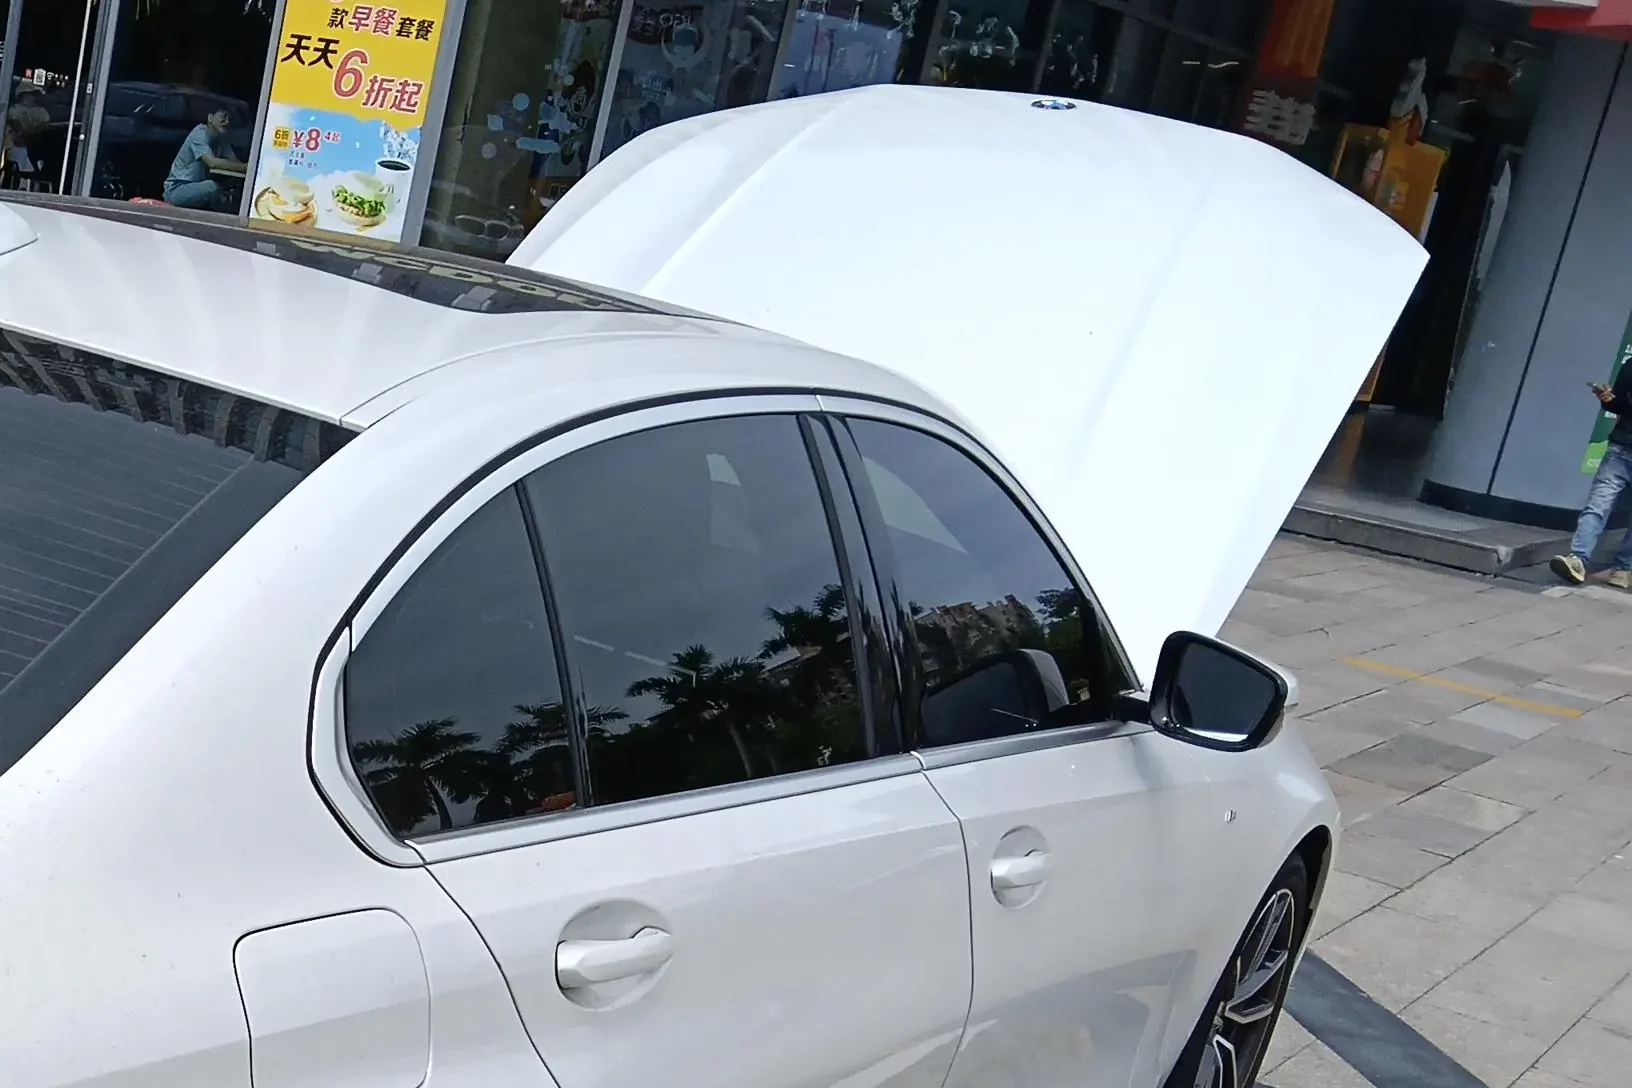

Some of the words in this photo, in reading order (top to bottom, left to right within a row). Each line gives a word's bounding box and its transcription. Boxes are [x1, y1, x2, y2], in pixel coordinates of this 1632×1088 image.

[328, 5, 435, 41] 款早餐套餐
[281, 34, 423, 113] 天天6折起
